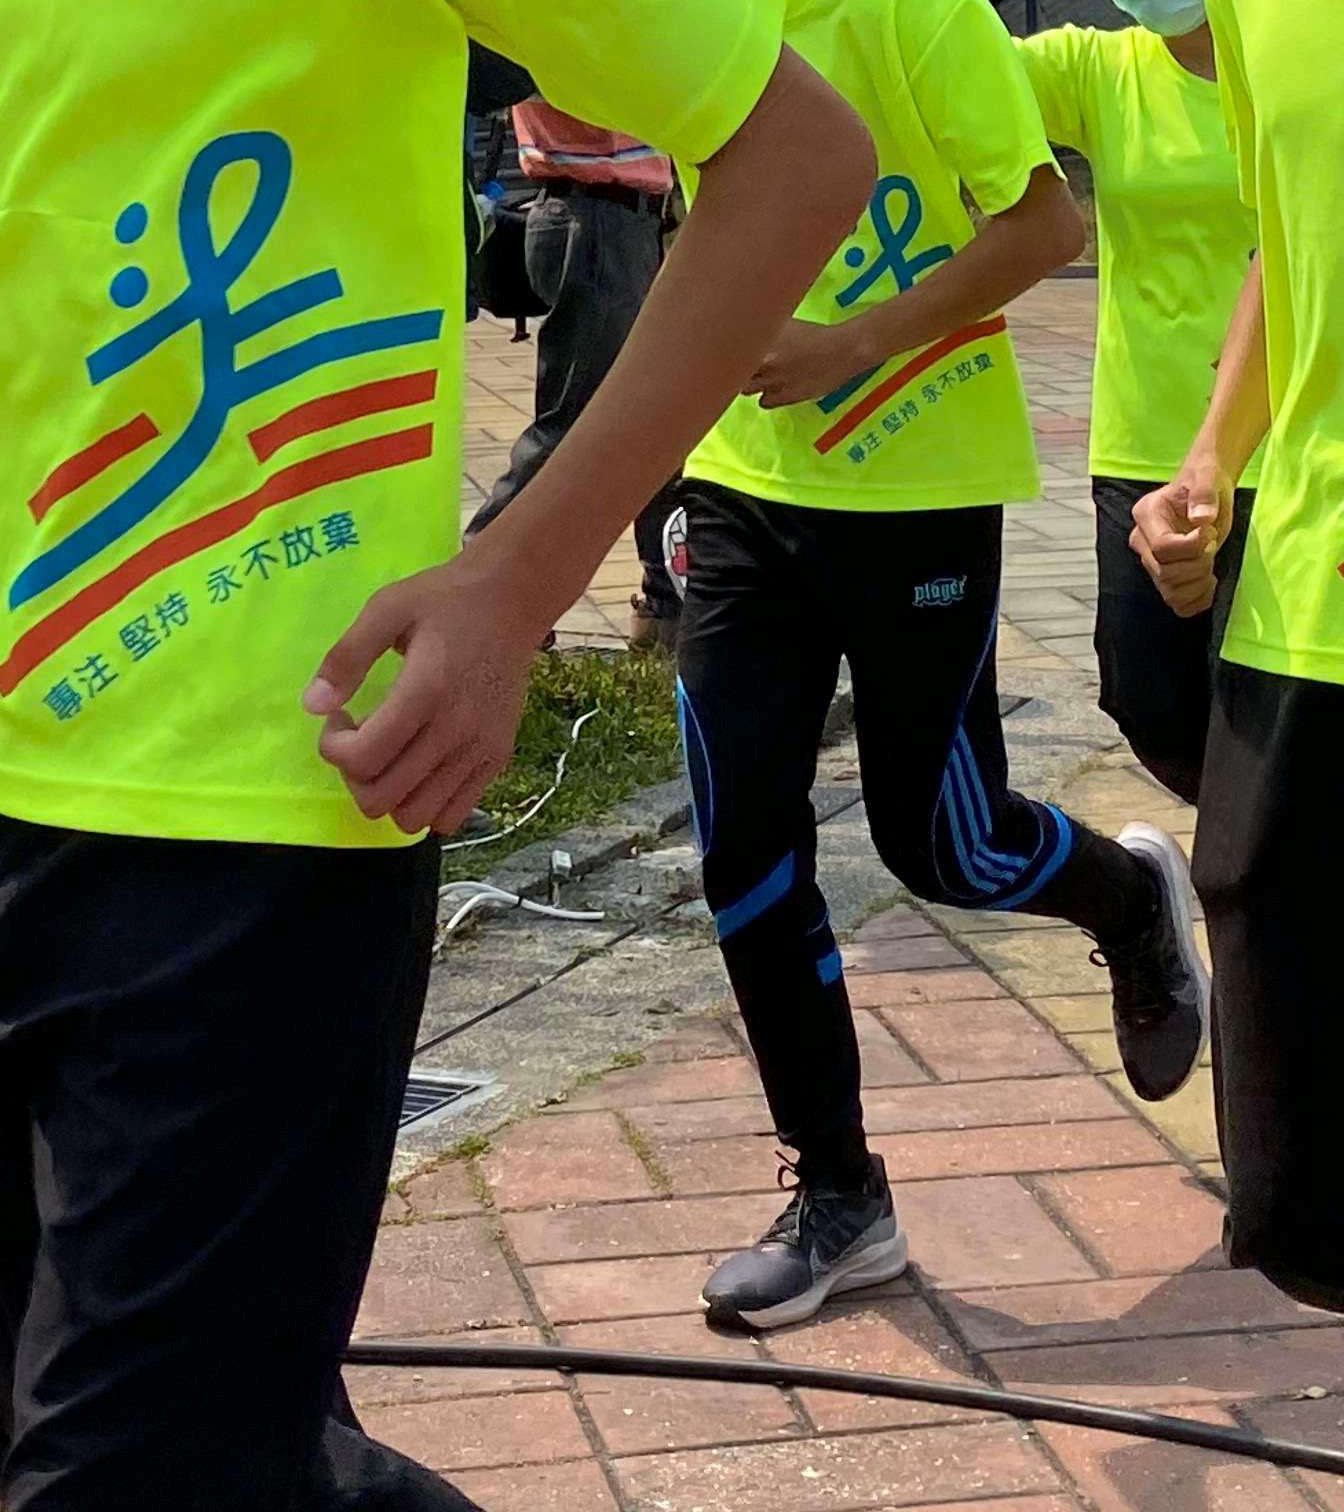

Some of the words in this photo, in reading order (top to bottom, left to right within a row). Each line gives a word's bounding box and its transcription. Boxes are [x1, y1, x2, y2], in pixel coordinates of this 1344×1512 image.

[42, 652, 120, 723] 專注
[118, 590, 192, 664] 堅持
[205, 510, 362, 605] 永不放棄
